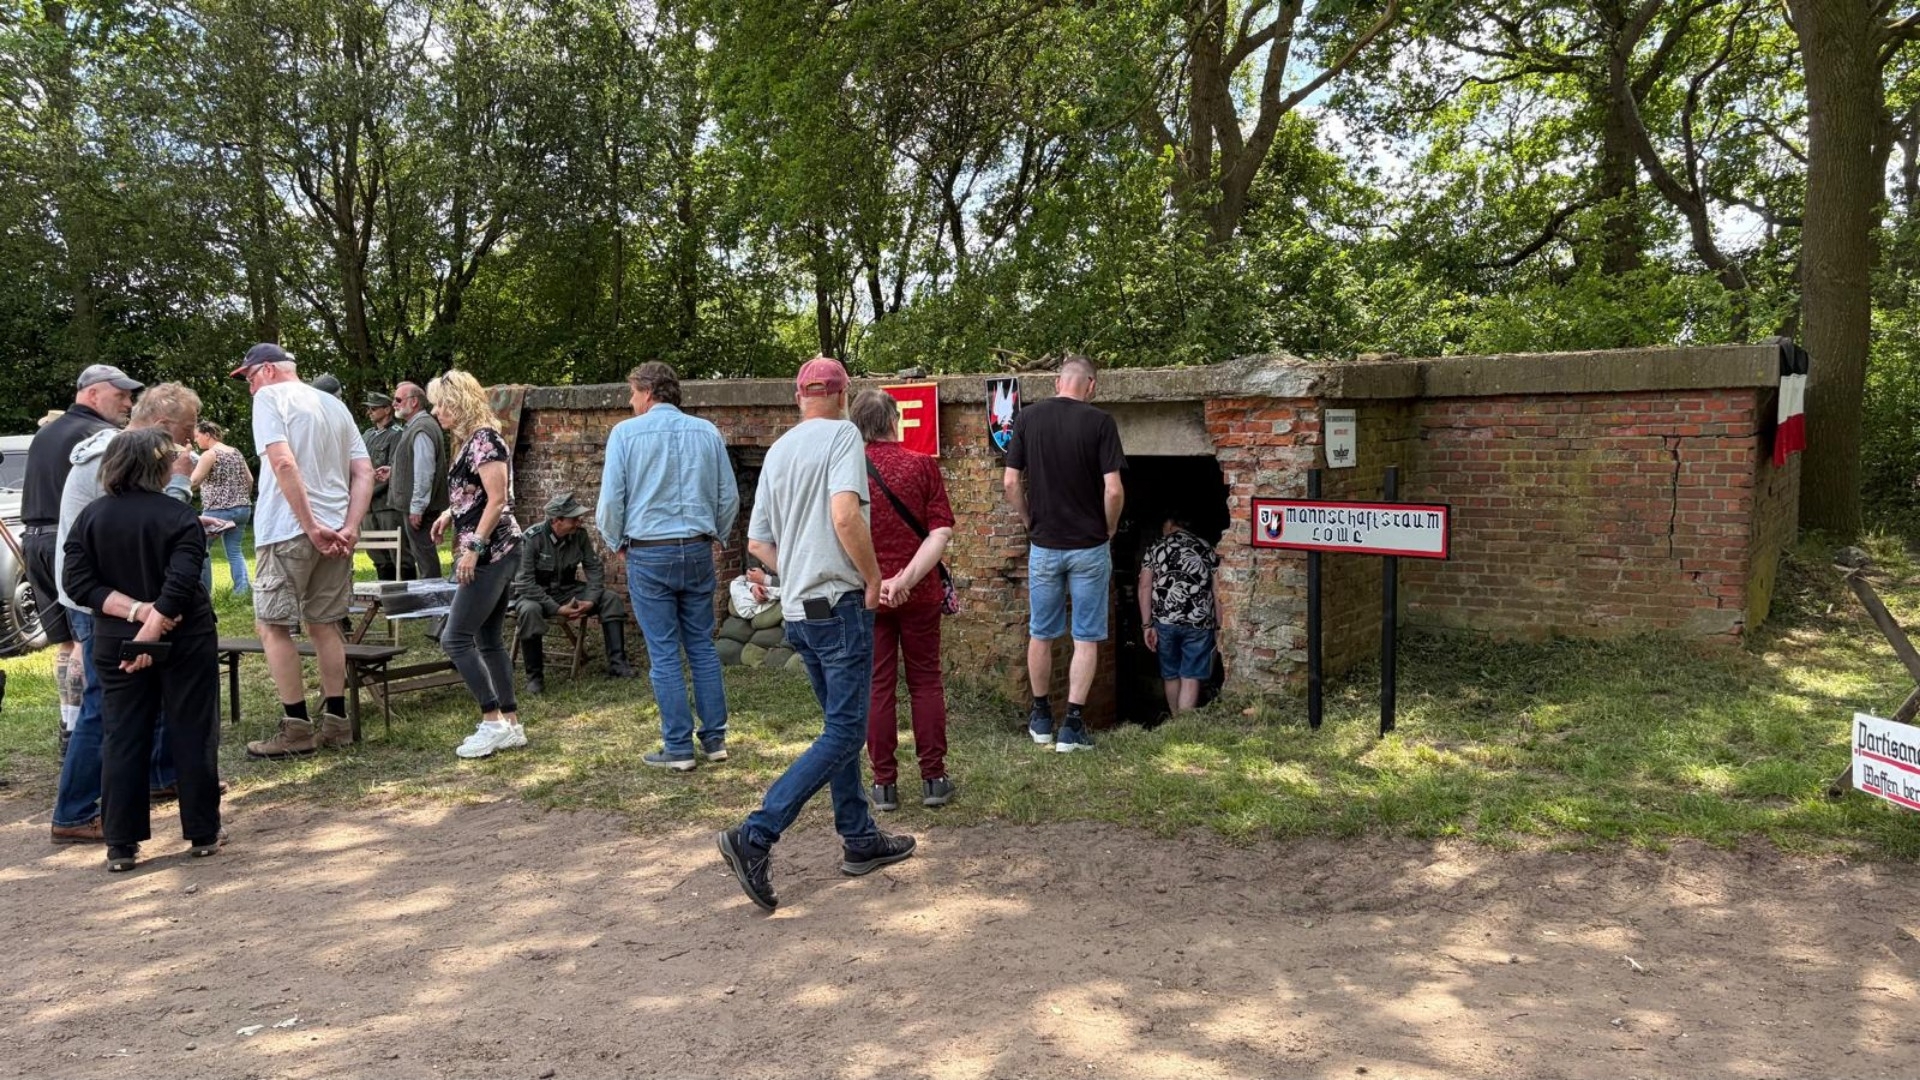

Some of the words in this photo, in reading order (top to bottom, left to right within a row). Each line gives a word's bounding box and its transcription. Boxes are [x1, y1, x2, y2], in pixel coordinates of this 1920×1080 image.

[896, 400, 923, 442] F
[1858, 721, 1920, 766] Partisan
[1863, 763, 1899, 796] Waffen
